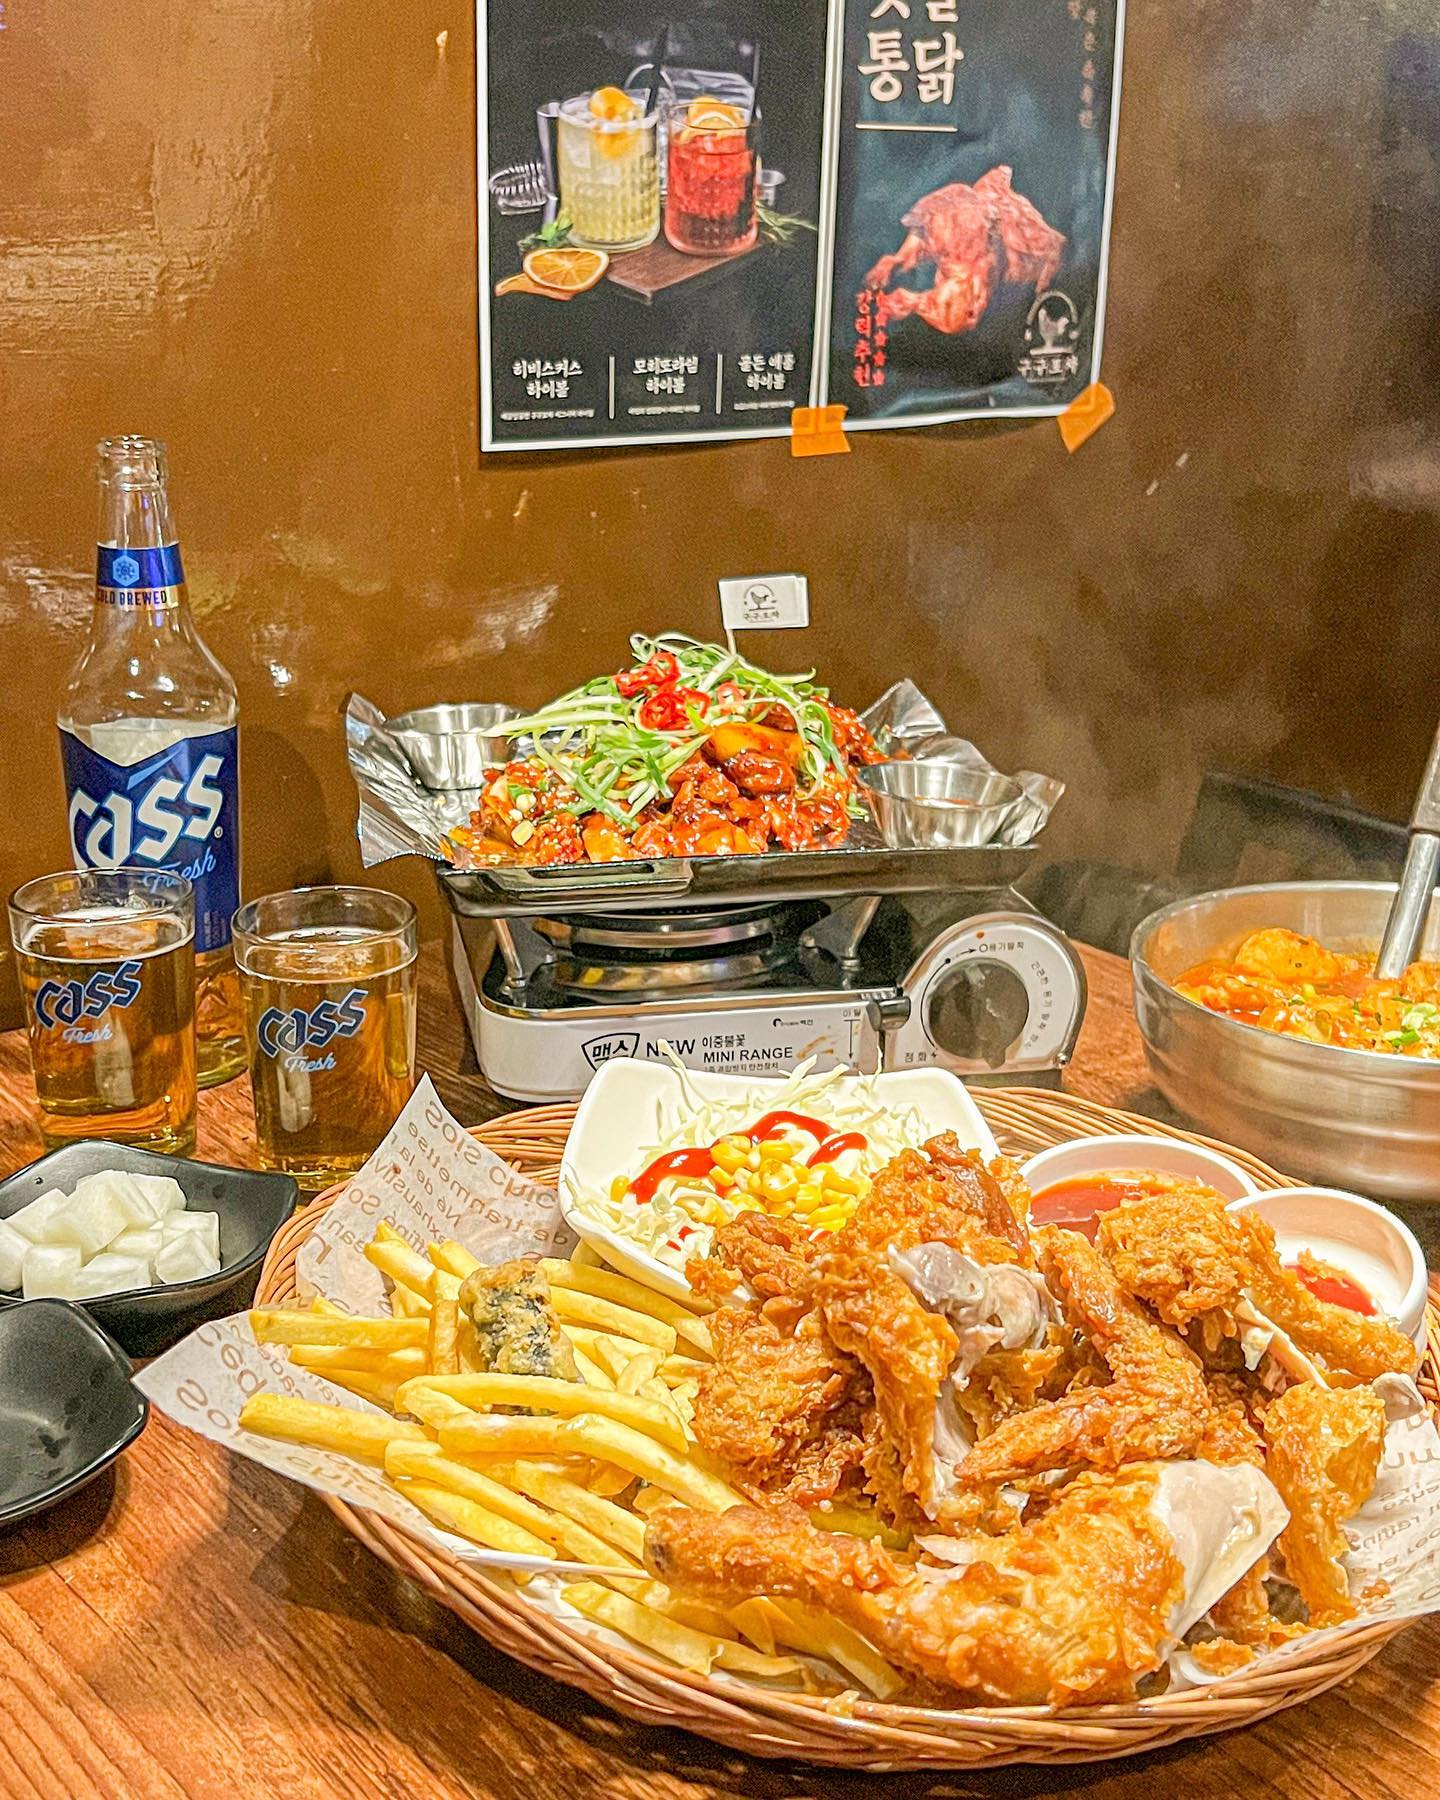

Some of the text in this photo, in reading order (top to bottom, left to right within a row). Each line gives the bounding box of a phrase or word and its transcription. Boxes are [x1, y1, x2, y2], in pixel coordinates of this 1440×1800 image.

[857, 29, 964, 104] 통닭
[512, 358, 583, 379] 히비스커스
[526, 379, 570, 399] 하이볼
[119, 590, 167, 606] BREWED
[62, 1023, 113, 1044] Fresh
[702, 1034, 746, 1049] 이중불꽃
[284, 1051, 337, 1073] Fresh
[704, 1047, 793, 1064] MINI RANGE
